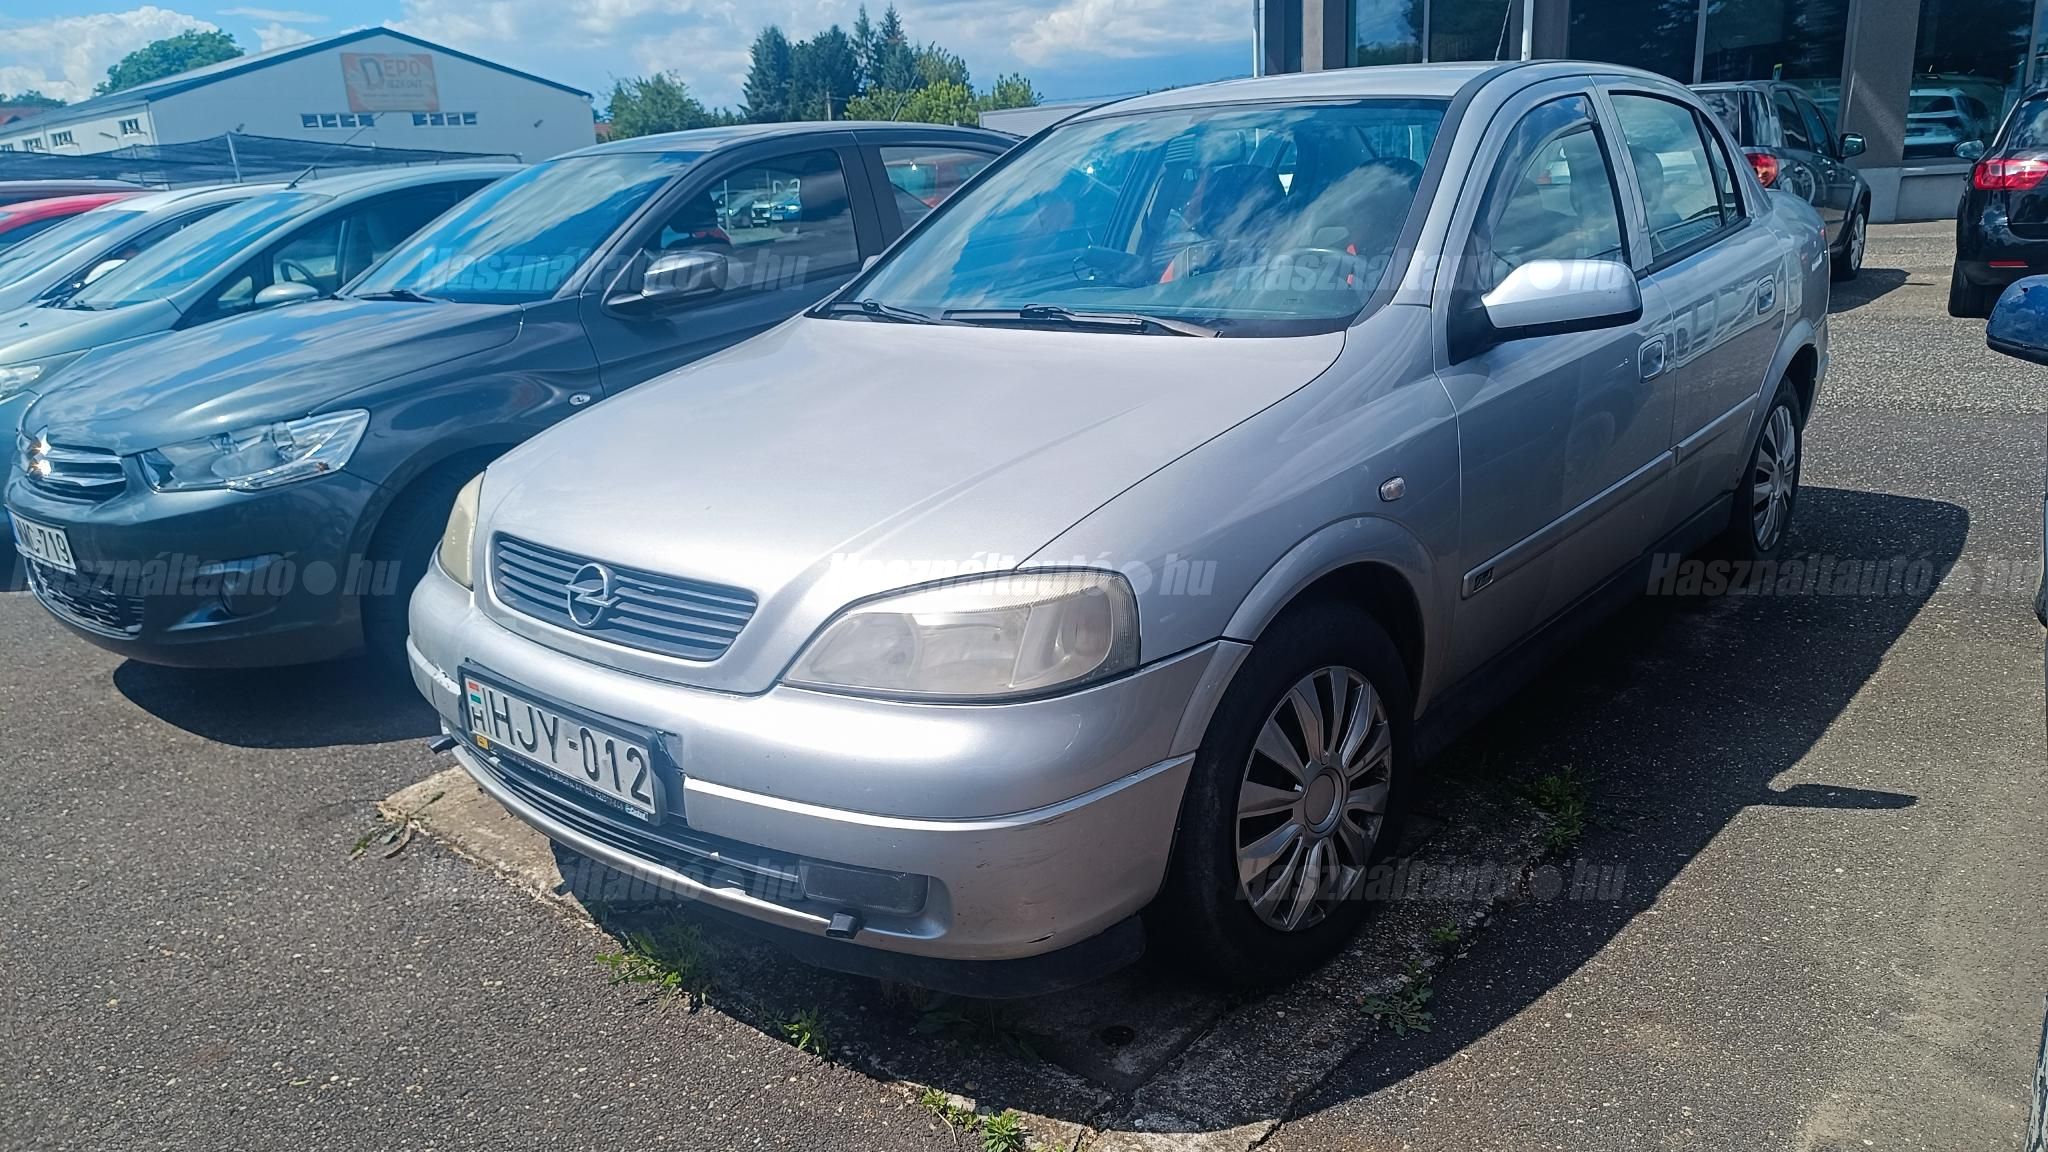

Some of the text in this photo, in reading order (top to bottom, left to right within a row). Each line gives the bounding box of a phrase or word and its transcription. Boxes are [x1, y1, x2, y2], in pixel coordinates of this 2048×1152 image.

[360, 57, 420, 89] DEPO
[471, 706, 486, 732] H
[488, 690, 651, 806] HJY-012
